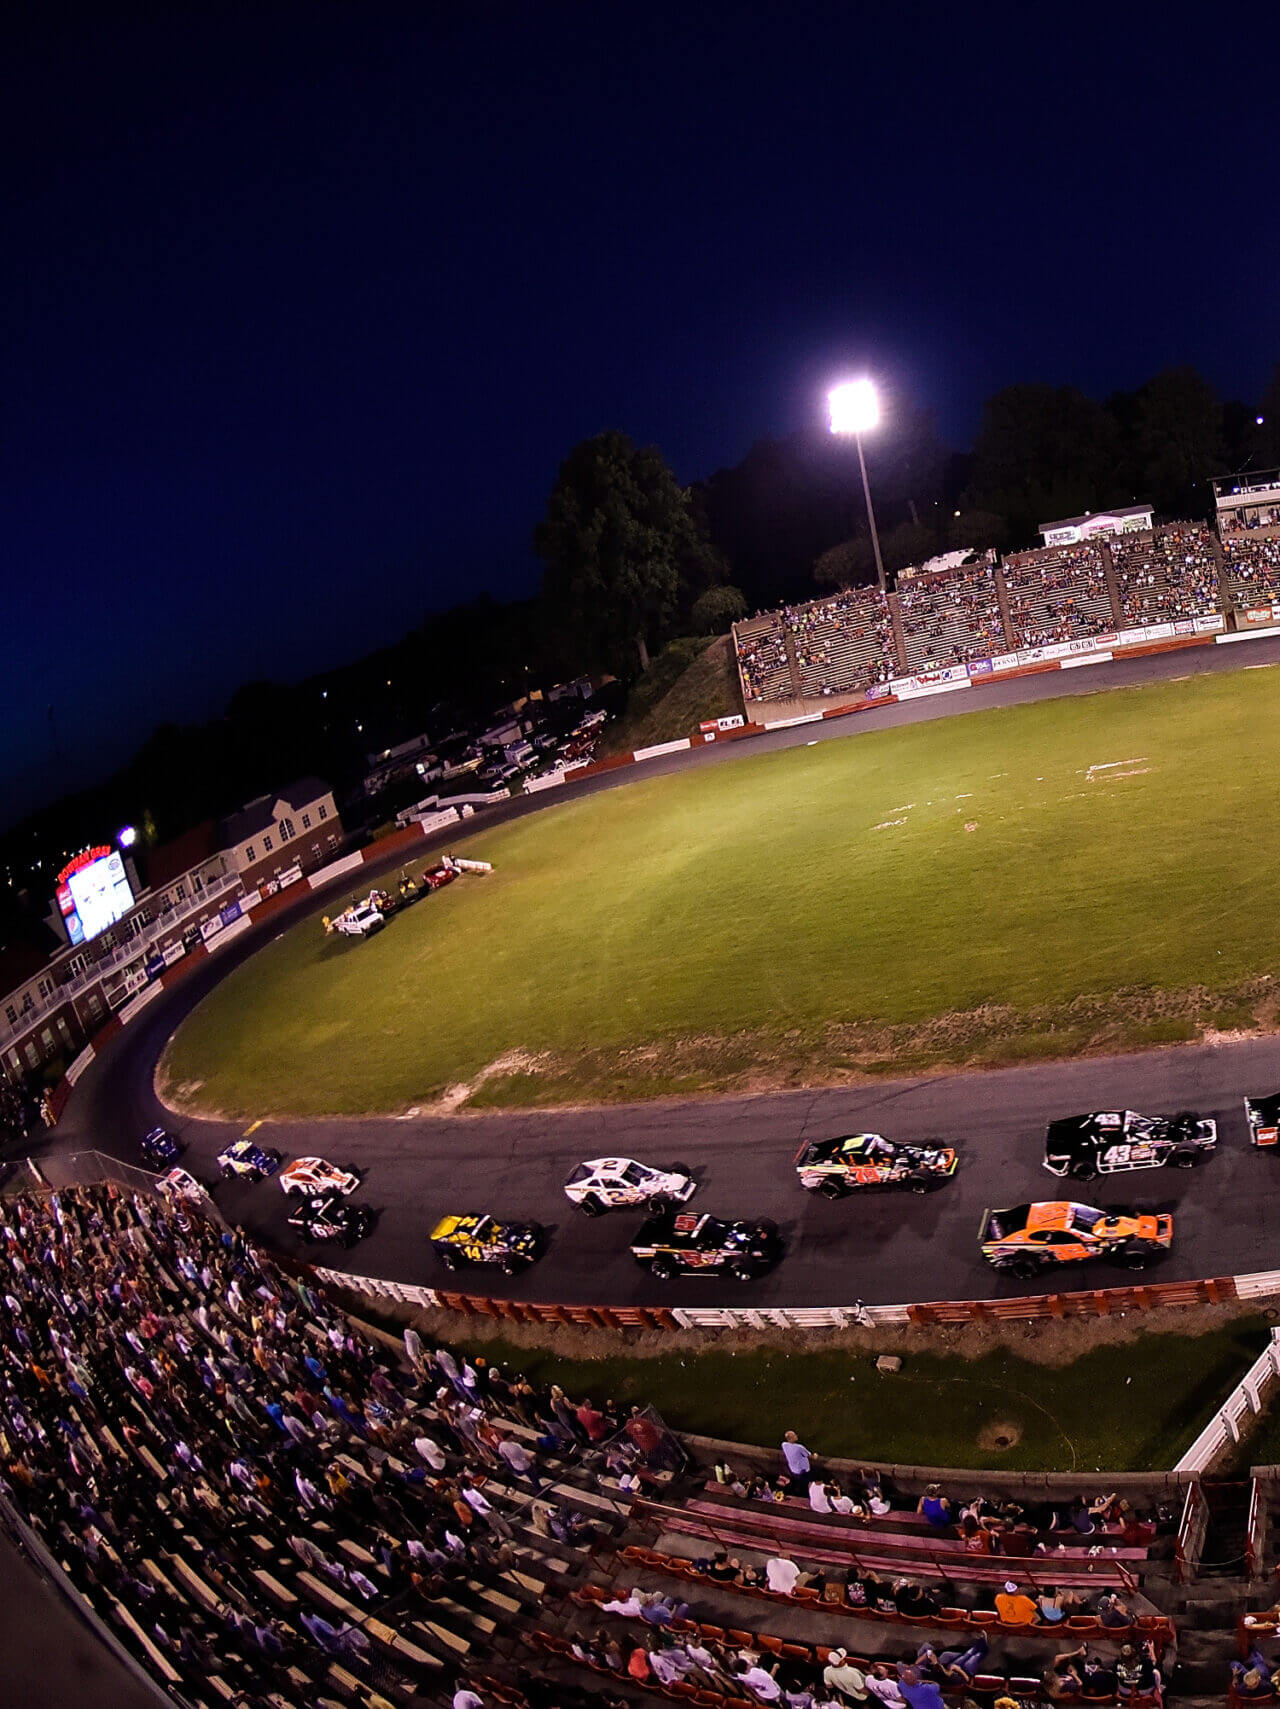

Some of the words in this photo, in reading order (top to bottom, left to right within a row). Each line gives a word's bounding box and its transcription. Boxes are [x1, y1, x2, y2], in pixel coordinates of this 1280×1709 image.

[57, 850, 90, 884] BOWMAN
[90, 844, 111, 859] GRAY
[1094, 1113, 1122, 1126] 43
[1103, 1145, 1132, 1163] 43
[601, 1160, 618, 1170] 2
[607, 1190, 628, 1203] 2
[464, 1246, 481, 1259] 14
